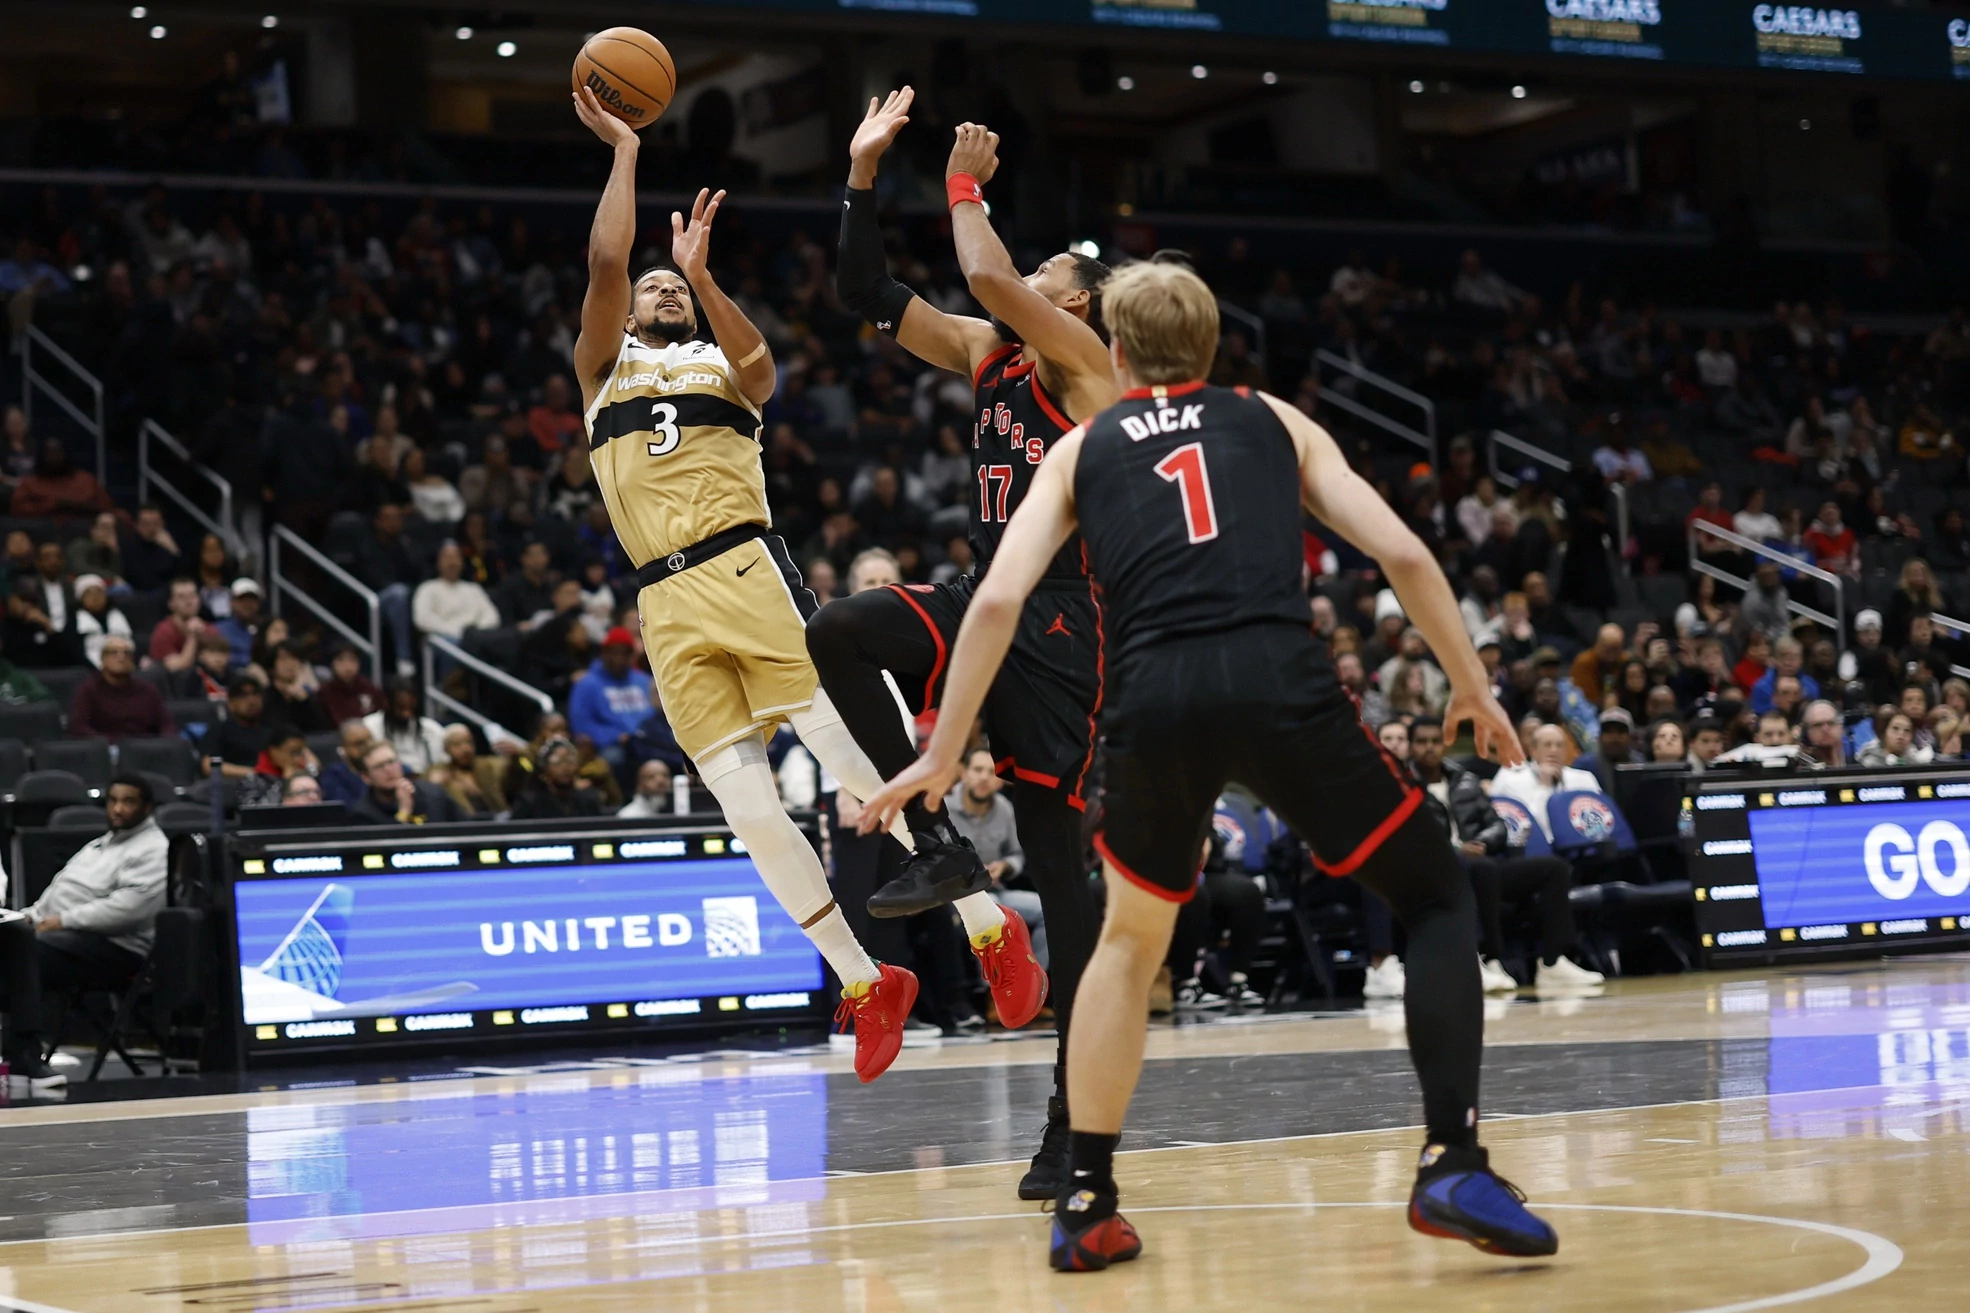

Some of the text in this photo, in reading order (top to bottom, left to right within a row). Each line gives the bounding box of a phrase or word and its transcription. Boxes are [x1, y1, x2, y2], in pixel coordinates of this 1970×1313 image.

[1753, 4, 1861, 39] CAESARS
[586, 69, 645, 118] Wilson
[617, 367, 723, 393] washington
[646, 401, 681, 457] 3
[1119, 403, 1205, 443] DICK
[977, 464, 1013, 523] 17
[1153, 440, 1219, 544] 1
[1863, 819, 1970, 900] GO
[479, 913, 693, 957] UNITED
